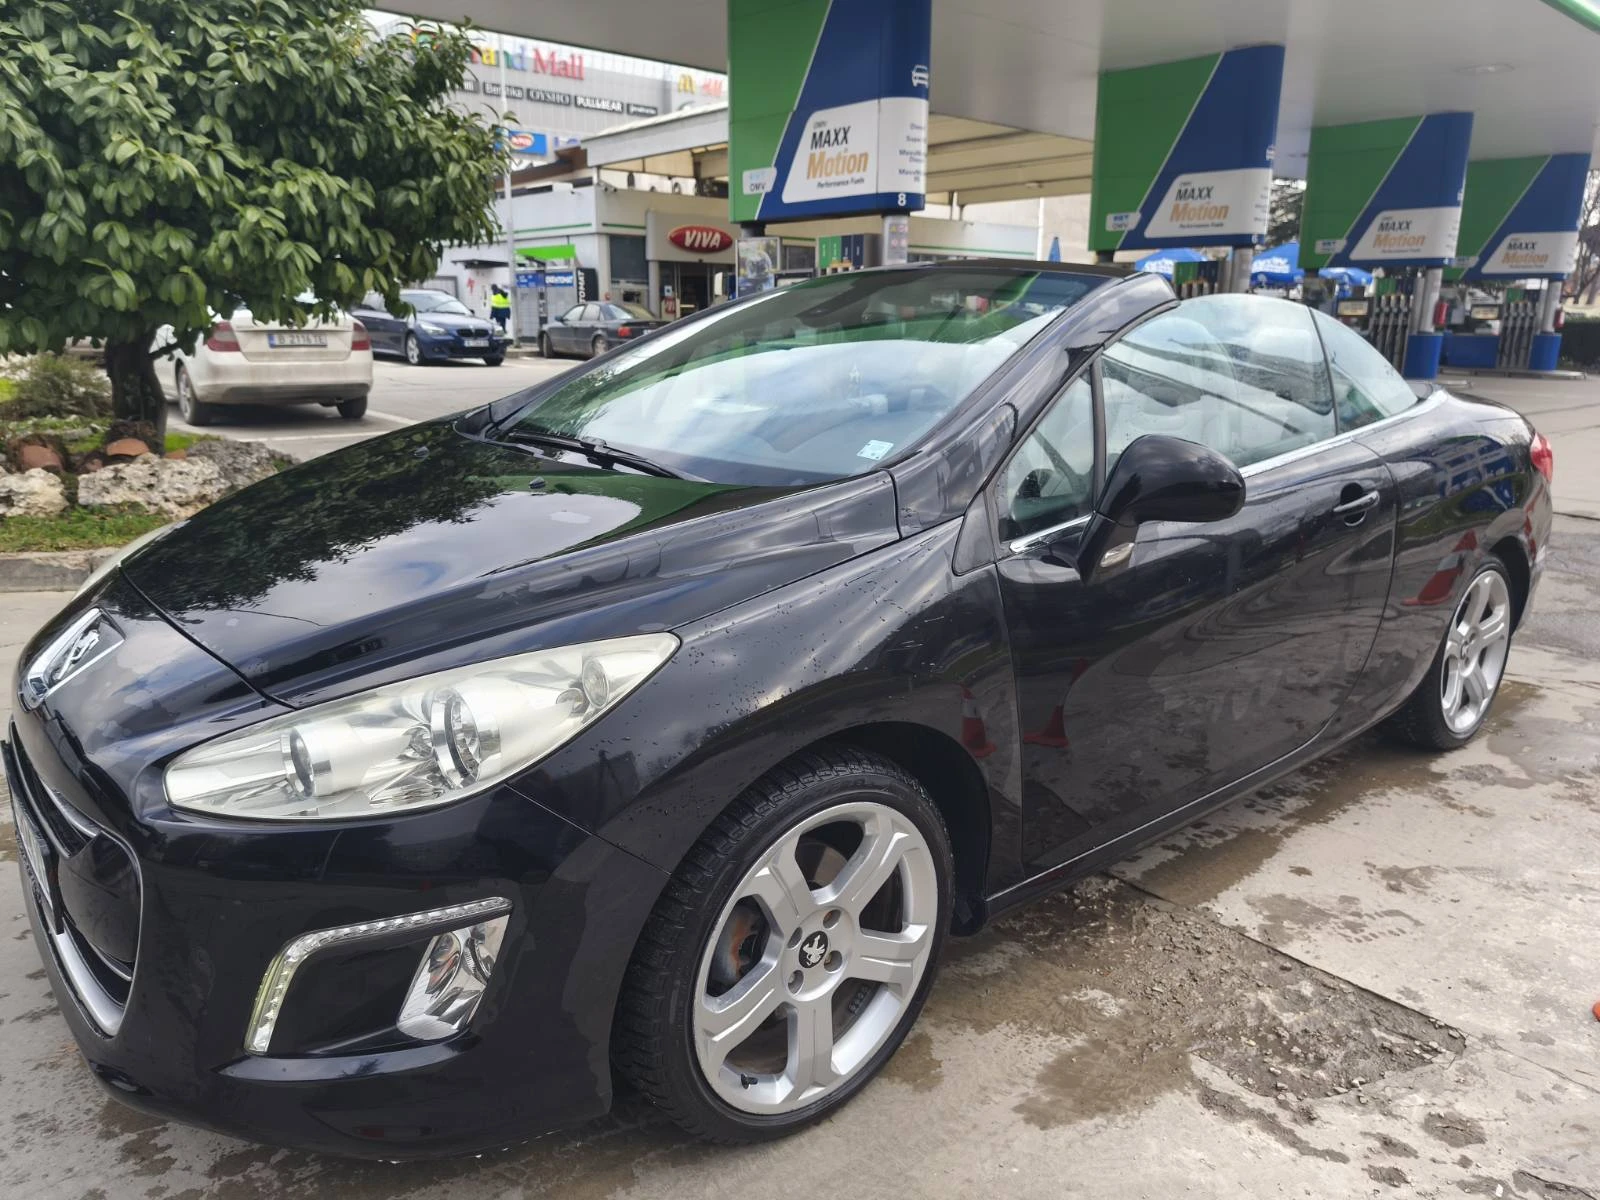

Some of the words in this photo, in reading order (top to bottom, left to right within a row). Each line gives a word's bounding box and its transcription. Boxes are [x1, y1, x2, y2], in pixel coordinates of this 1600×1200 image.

[533, 48, 585, 80] Mall
[529, 90, 570, 105] OYSHO
[810, 126, 851, 150] MAXX
[807, 150, 869, 180] Motion
[897, 192, 907, 207] 8
[1176, 186, 1214, 202] MAXX
[1170, 203, 1230, 223] Motion
[1378, 220, 1412, 233] MAXX
[684, 229, 721, 249] VIVA
[1373, 233, 1426, 249] Motion
